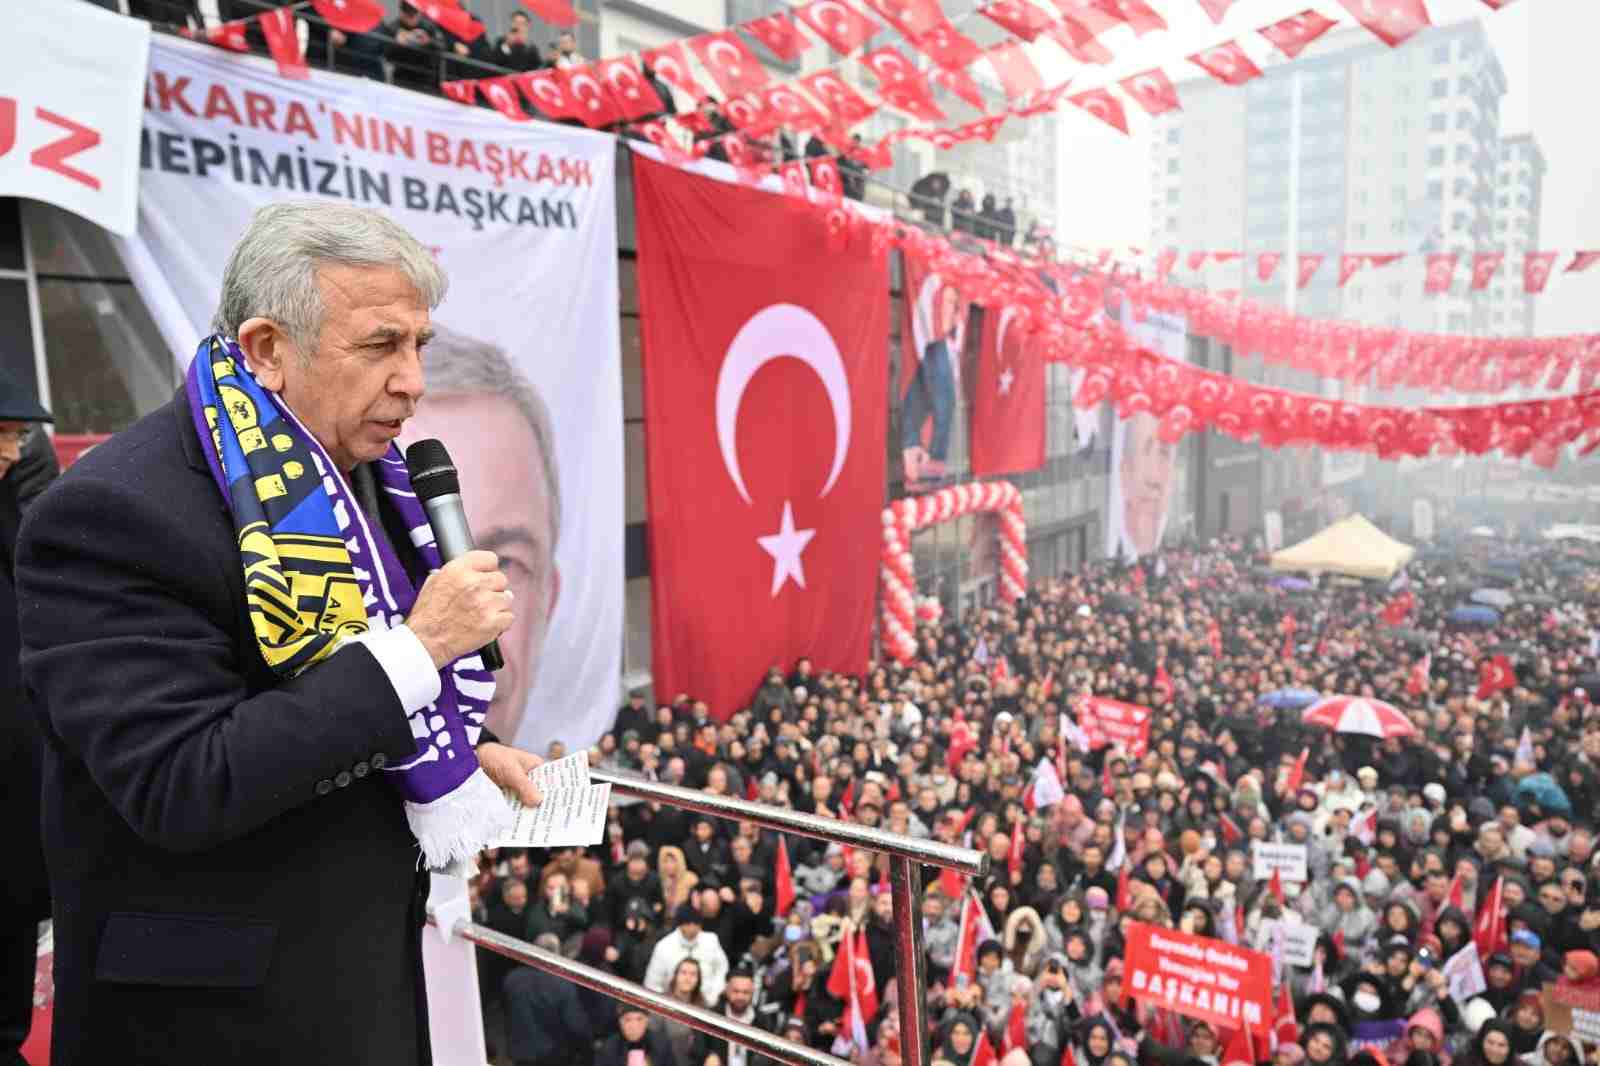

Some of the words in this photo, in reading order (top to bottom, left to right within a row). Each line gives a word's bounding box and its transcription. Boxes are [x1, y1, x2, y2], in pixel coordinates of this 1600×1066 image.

[144, 71, 415, 160] KARA'NIN
[426, 129, 593, 188] BAŞKANI
[403, 176, 577, 231] BAŞKANI
[1132, 969, 1262, 1024] BAŞKANIM
